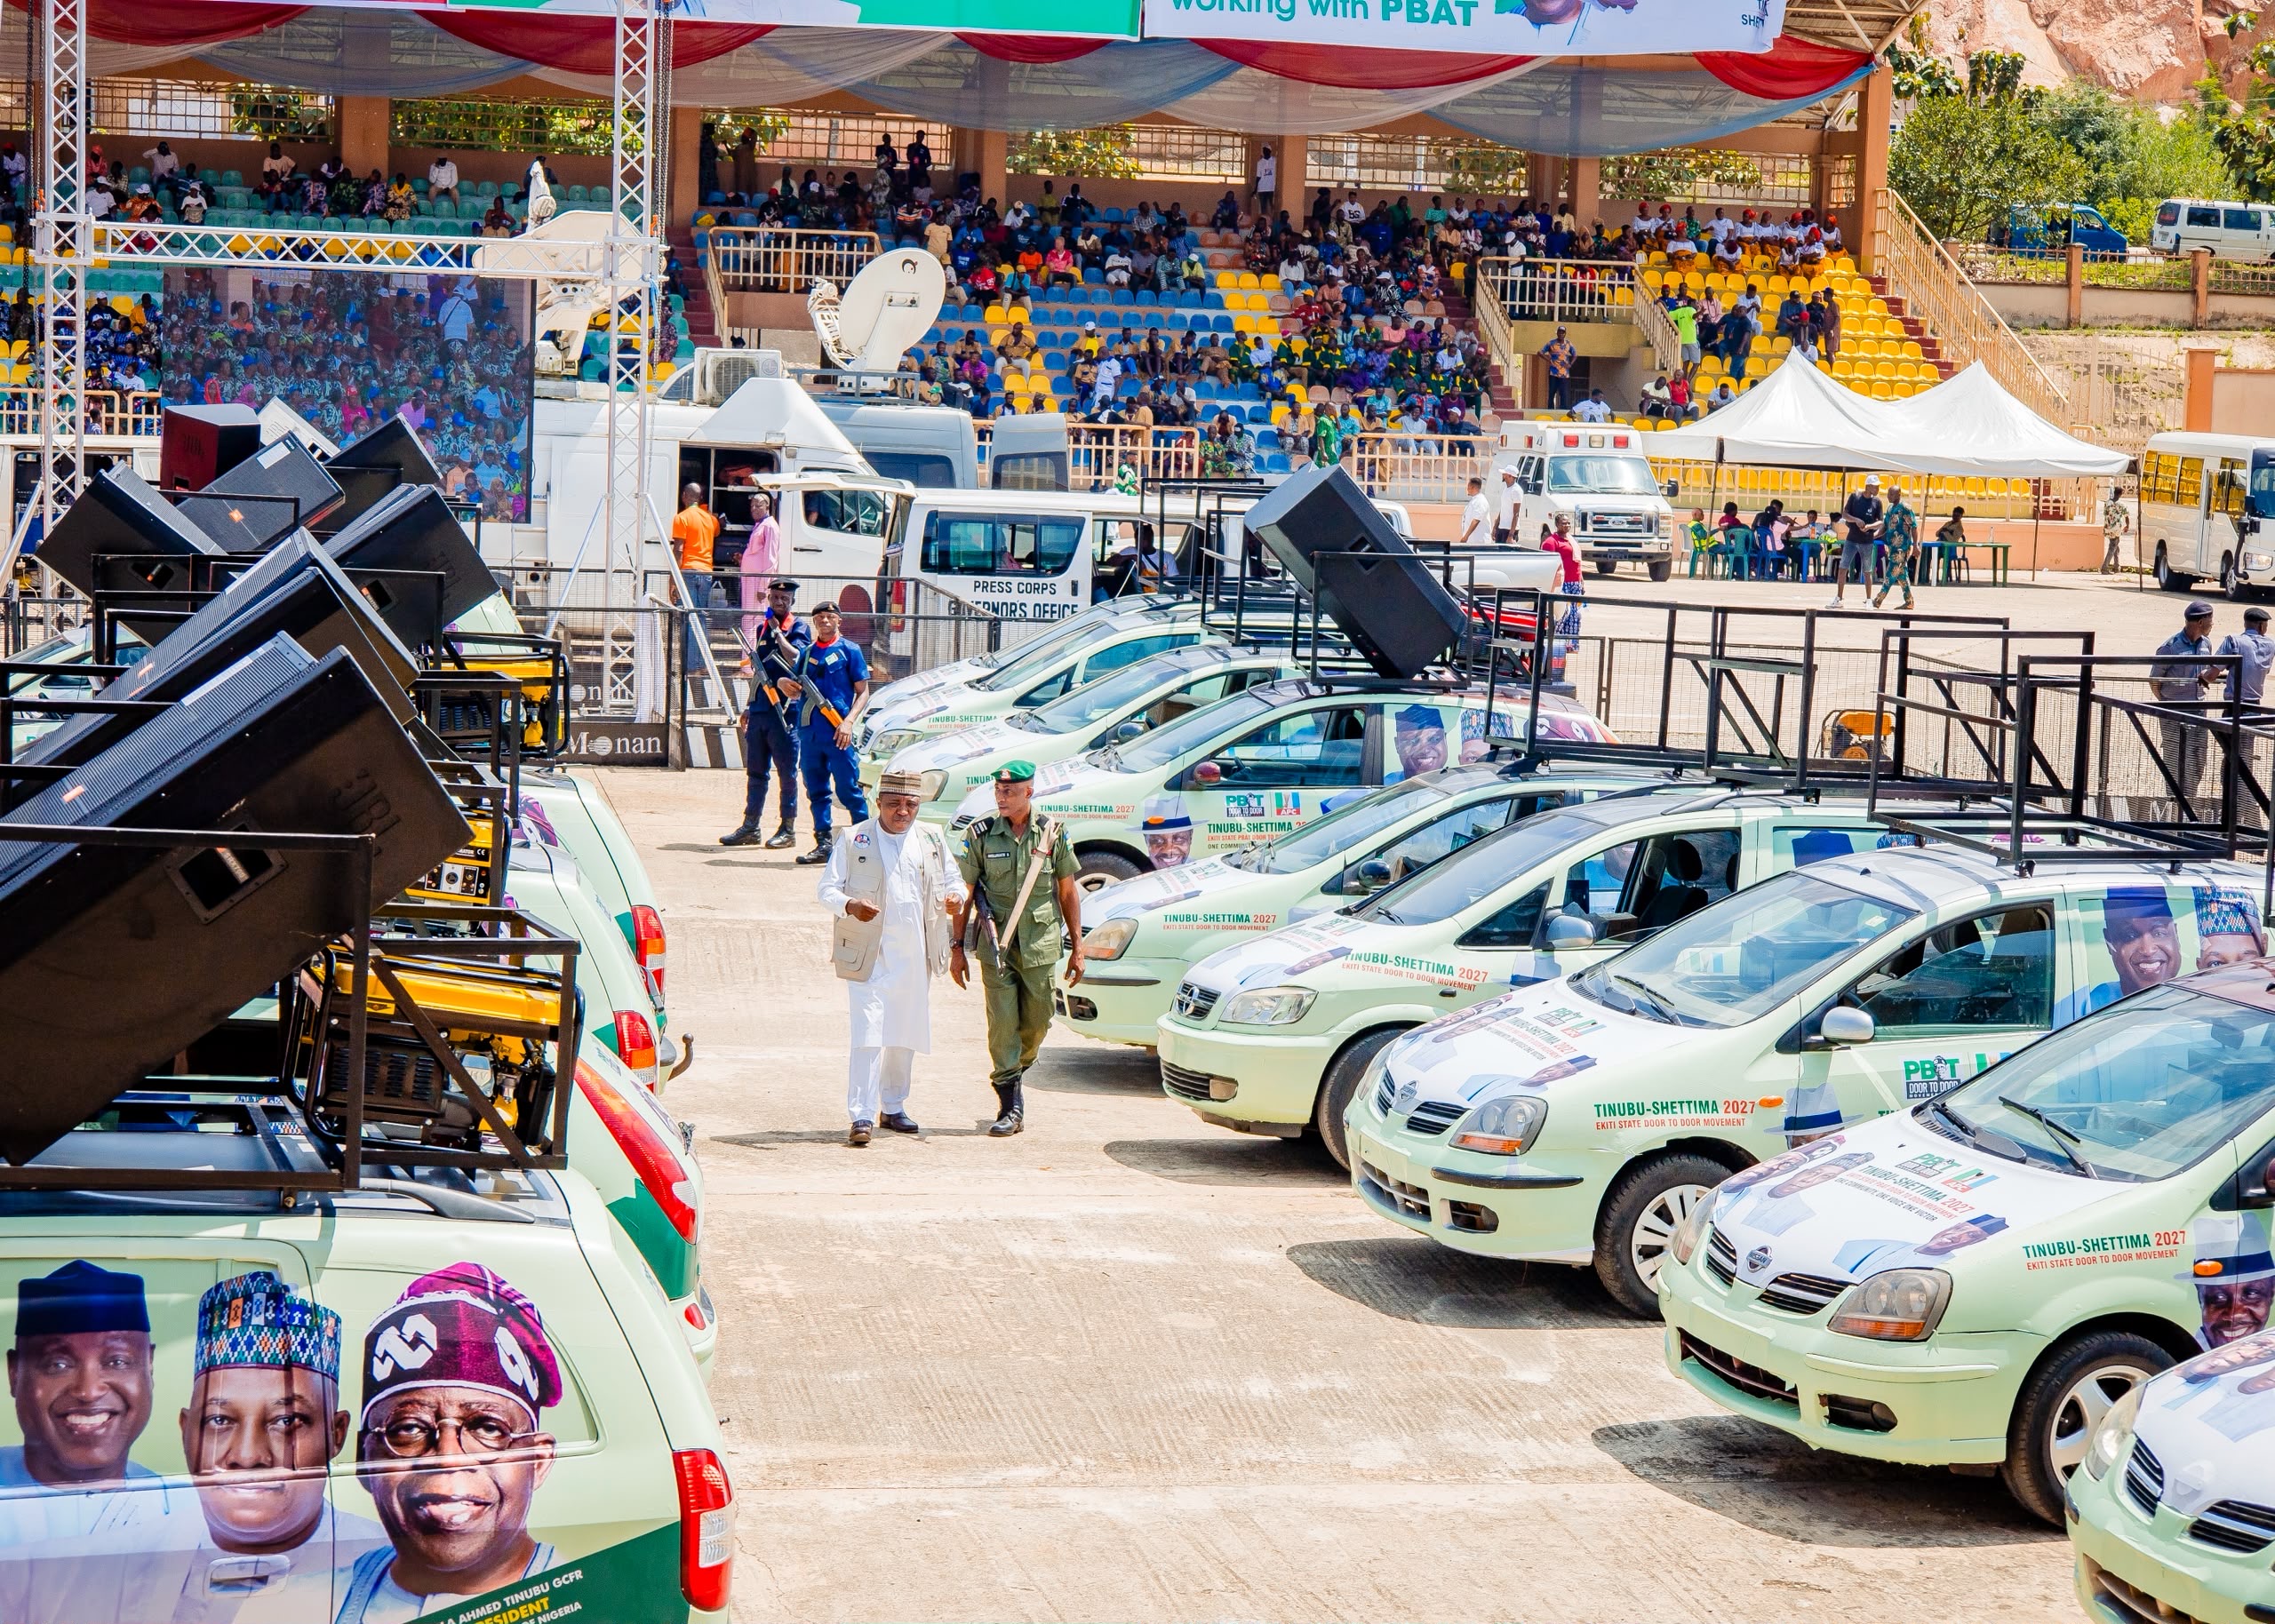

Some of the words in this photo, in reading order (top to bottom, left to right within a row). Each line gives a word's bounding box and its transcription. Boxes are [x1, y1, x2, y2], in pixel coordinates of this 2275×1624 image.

[1173, 0, 1295, 21] working
[1307, 0, 1369, 20] with
[1380, 0, 1479, 27] PBAT
[973, 580, 1012, 593] PRESS
[1017, 582, 1057, 595] CORPS
[1208, 822, 1292, 833] TINUBU-SHETTIMA
[1163, 914, 1250, 923] TINUBU-SHETTIMA
[1253, 914, 1276, 923] 2027
[1345, 952, 1454, 976] TINUBU-SHETTIMA
[1458, 967, 1489, 983] 2027
[1361, 965, 1382, 974] STATE
[1384, 968, 1403, 978] DOOR
[1416, 974, 1436, 983] DOOR
[1437, 977, 1476, 991] MOVEMENT
[1909, 1083, 1928, 1094] DOOR
[1929, 1082, 1938, 1093] TO
[1594, 1100, 1720, 1118] TINUBU-SHETTIMA
[1723, 1100, 1756, 1114] 2027
[1596, 1121, 1616, 1130] EKITI
[1618, 1119, 1641, 1129] STATE
[1644, 1118, 1666, 1128] DOOR
[1669, 1118, 1678, 1127] TO
[1704, 1118, 1746, 1126] MOVEMENT
[1859, 1165, 1948, 1202] TINUBU-SHETTIMA
[1940, 1198, 1976, 1214] 2027
[2023, 1233, 2151, 1259] TINUBU-SHETTIMA
[2154, 1230, 2186, 1246] 2027
[2027, 1260, 2048, 1270] EKITI
[2050, 1258, 2073, 1269] STATE
[2075, 1256, 2097, 1266] DOOR
[2099, 1254, 2110, 1263] TO
[2112, 1253, 2134, 1263] DOOR
[2135, 1249, 2179, 1260] MOVEMENT
[459, 1601, 502, 1624] AHMED
[503, 1581, 550, 1606] TINUBU
[552, 1570, 584, 1588] GCFR
[537, 1602, 582, 1623] NIGERIA
